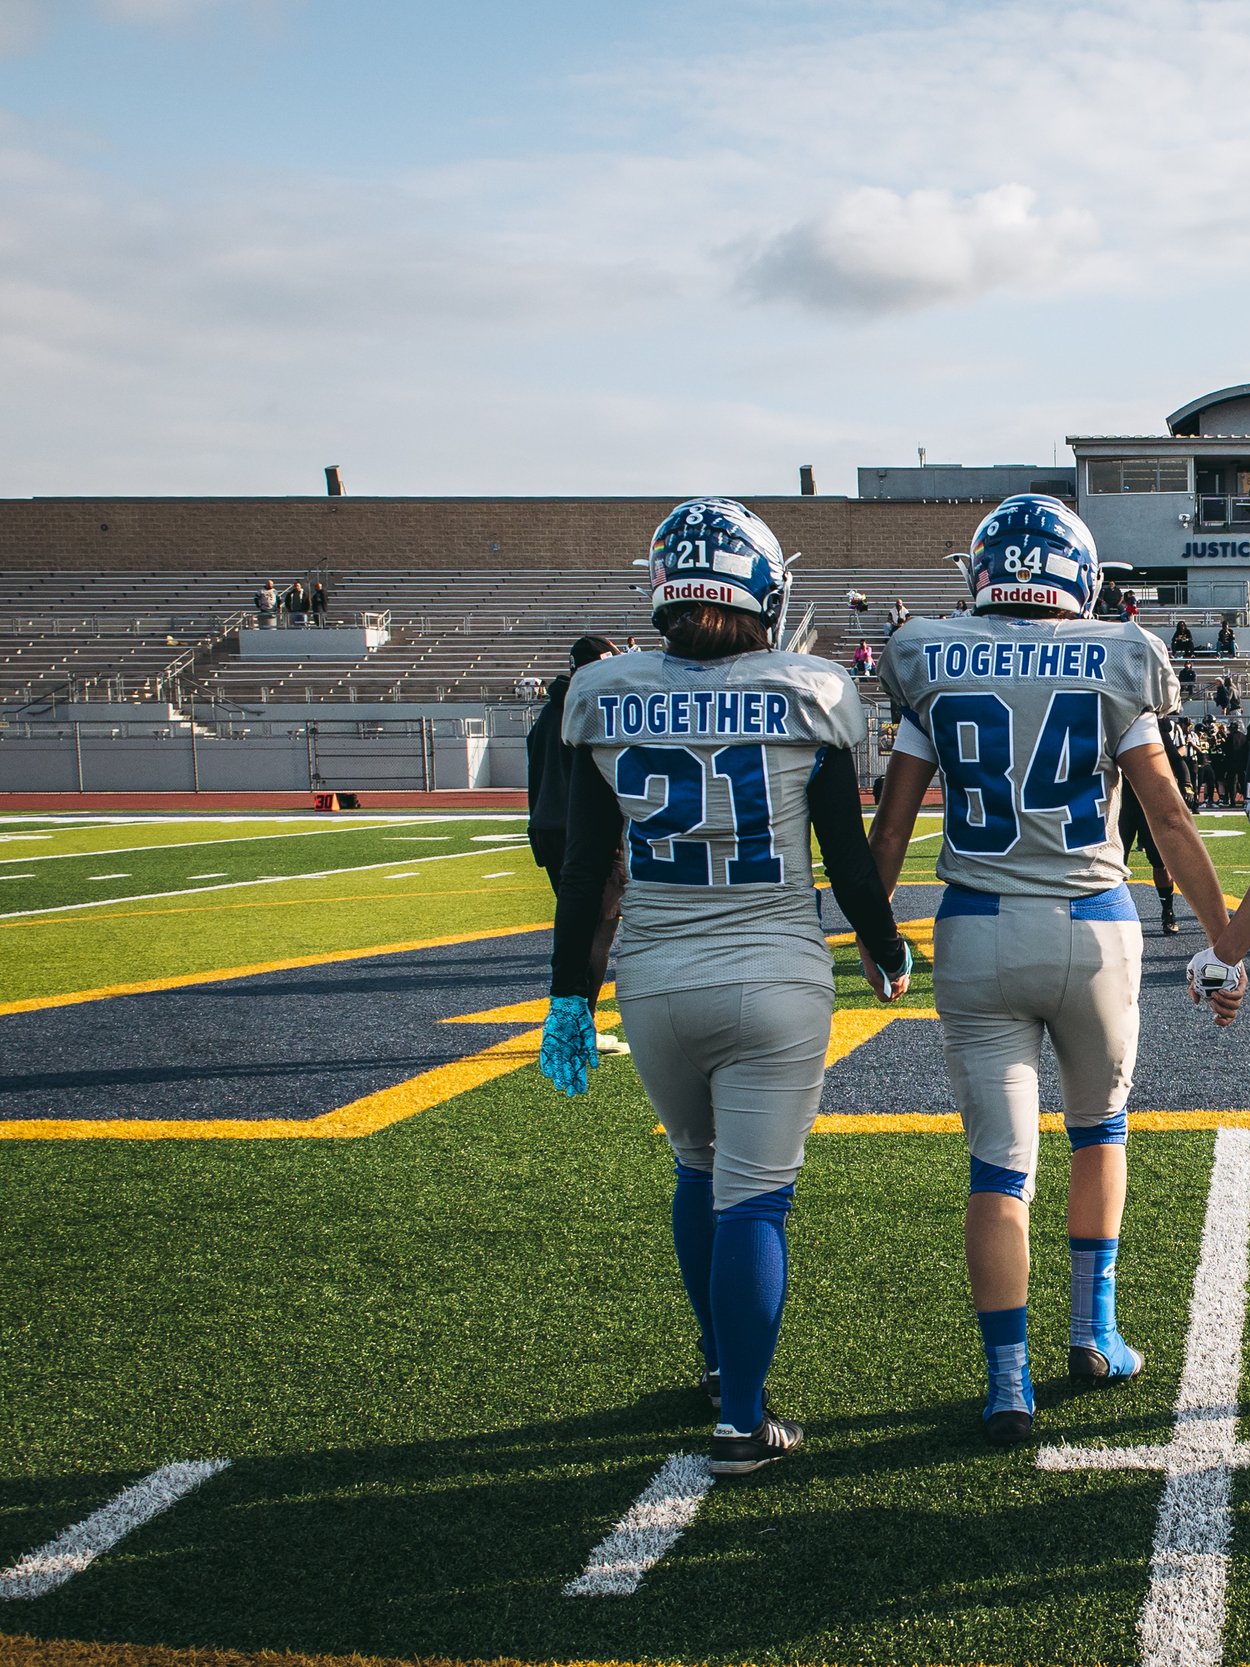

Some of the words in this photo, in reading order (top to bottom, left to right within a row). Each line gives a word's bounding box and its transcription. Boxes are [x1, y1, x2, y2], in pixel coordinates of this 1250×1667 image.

[676, 540, 710, 570] 21
[1004, 545, 1042, 575] 84
[663, 583, 733, 603] Riddell
[991, 587, 1058, 605] Riddell
[923, 641, 1108, 683] TOGETHER
[597, 691, 790, 738] TOGETHER
[929, 690, 1109, 857] 84
[315, 795, 333, 809] 30
[615, 743, 785, 886] 21
